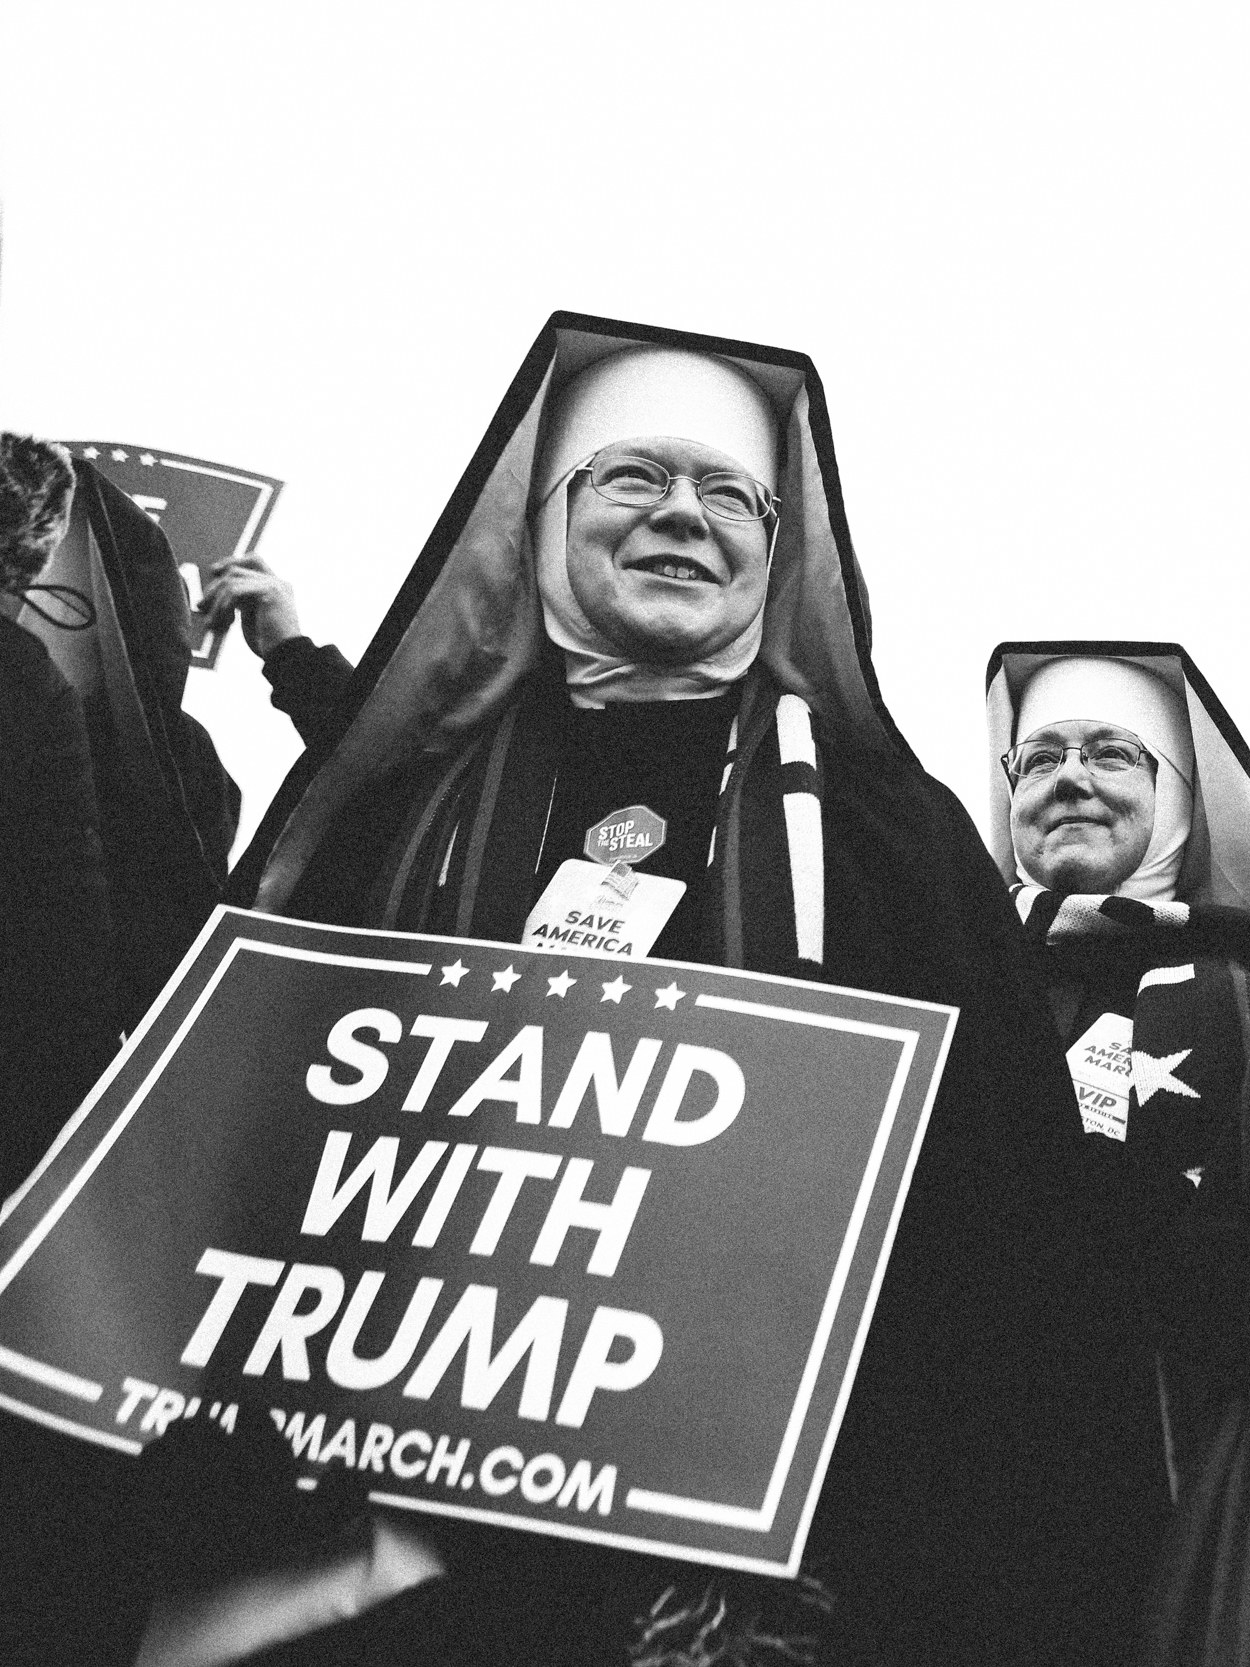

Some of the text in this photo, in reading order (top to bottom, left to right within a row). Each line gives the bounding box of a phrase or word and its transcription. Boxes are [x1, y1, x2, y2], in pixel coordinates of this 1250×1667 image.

[598, 820, 634, 840] STOP
[608, 832, 654, 851] STEAL
[565, 911, 625, 934] SAVE
[532, 924, 633, 956] AMERICA
[306, 1008, 746, 1148] STAND
[1079, 1086, 1117, 1108] VIP
[300, 1131, 651, 1277] WITH
[181, 1248, 664, 1428] TRUMP
[116, 1376, 618, 1516] TRMARCH.COM
